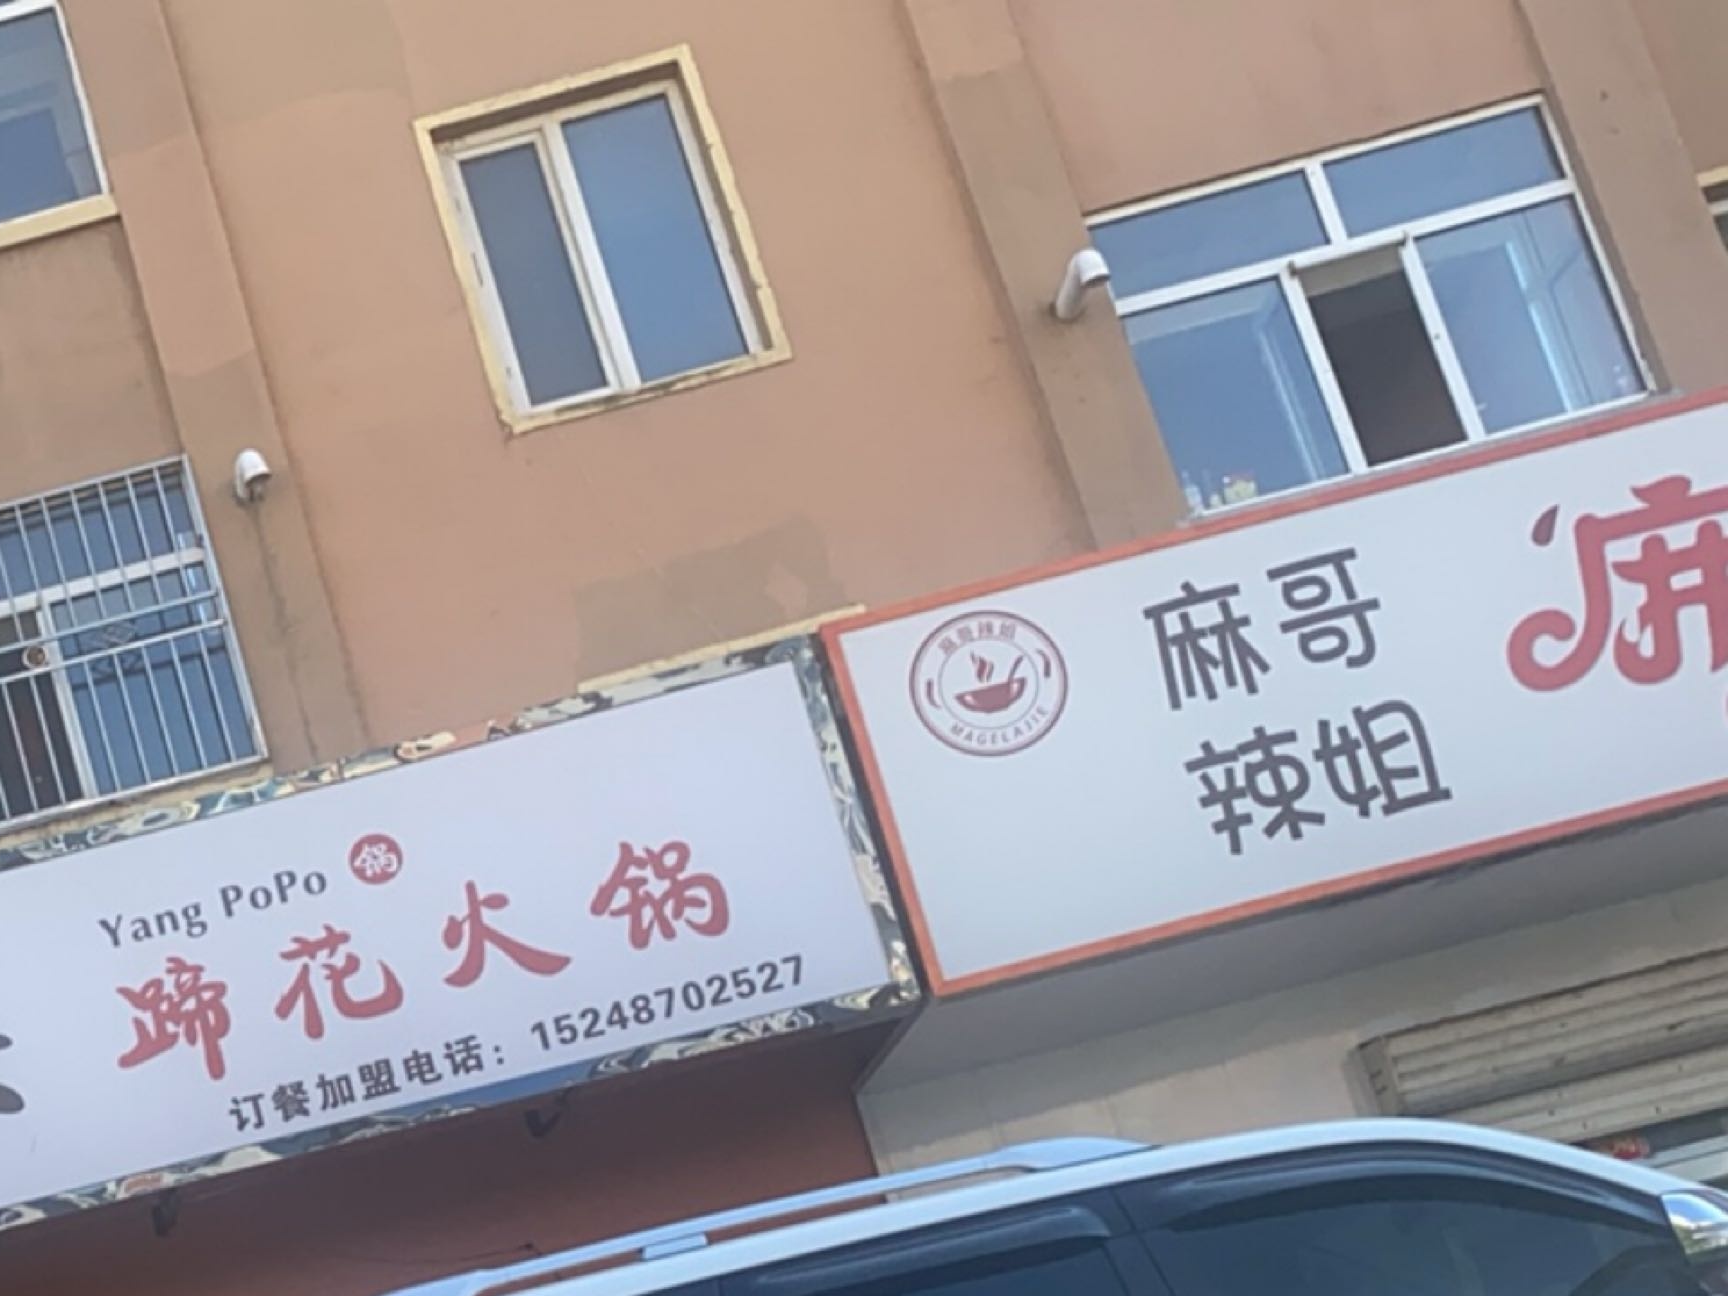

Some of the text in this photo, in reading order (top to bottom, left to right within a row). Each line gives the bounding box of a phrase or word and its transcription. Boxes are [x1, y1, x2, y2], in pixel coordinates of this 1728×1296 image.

[1142, 546, 1382, 712] 麻哥
[1184, 700, 1452, 857] 辣姐
[98, 868, 328, 948] Yang PoPo
[116, 841, 729, 1081] 蹄花火锅
